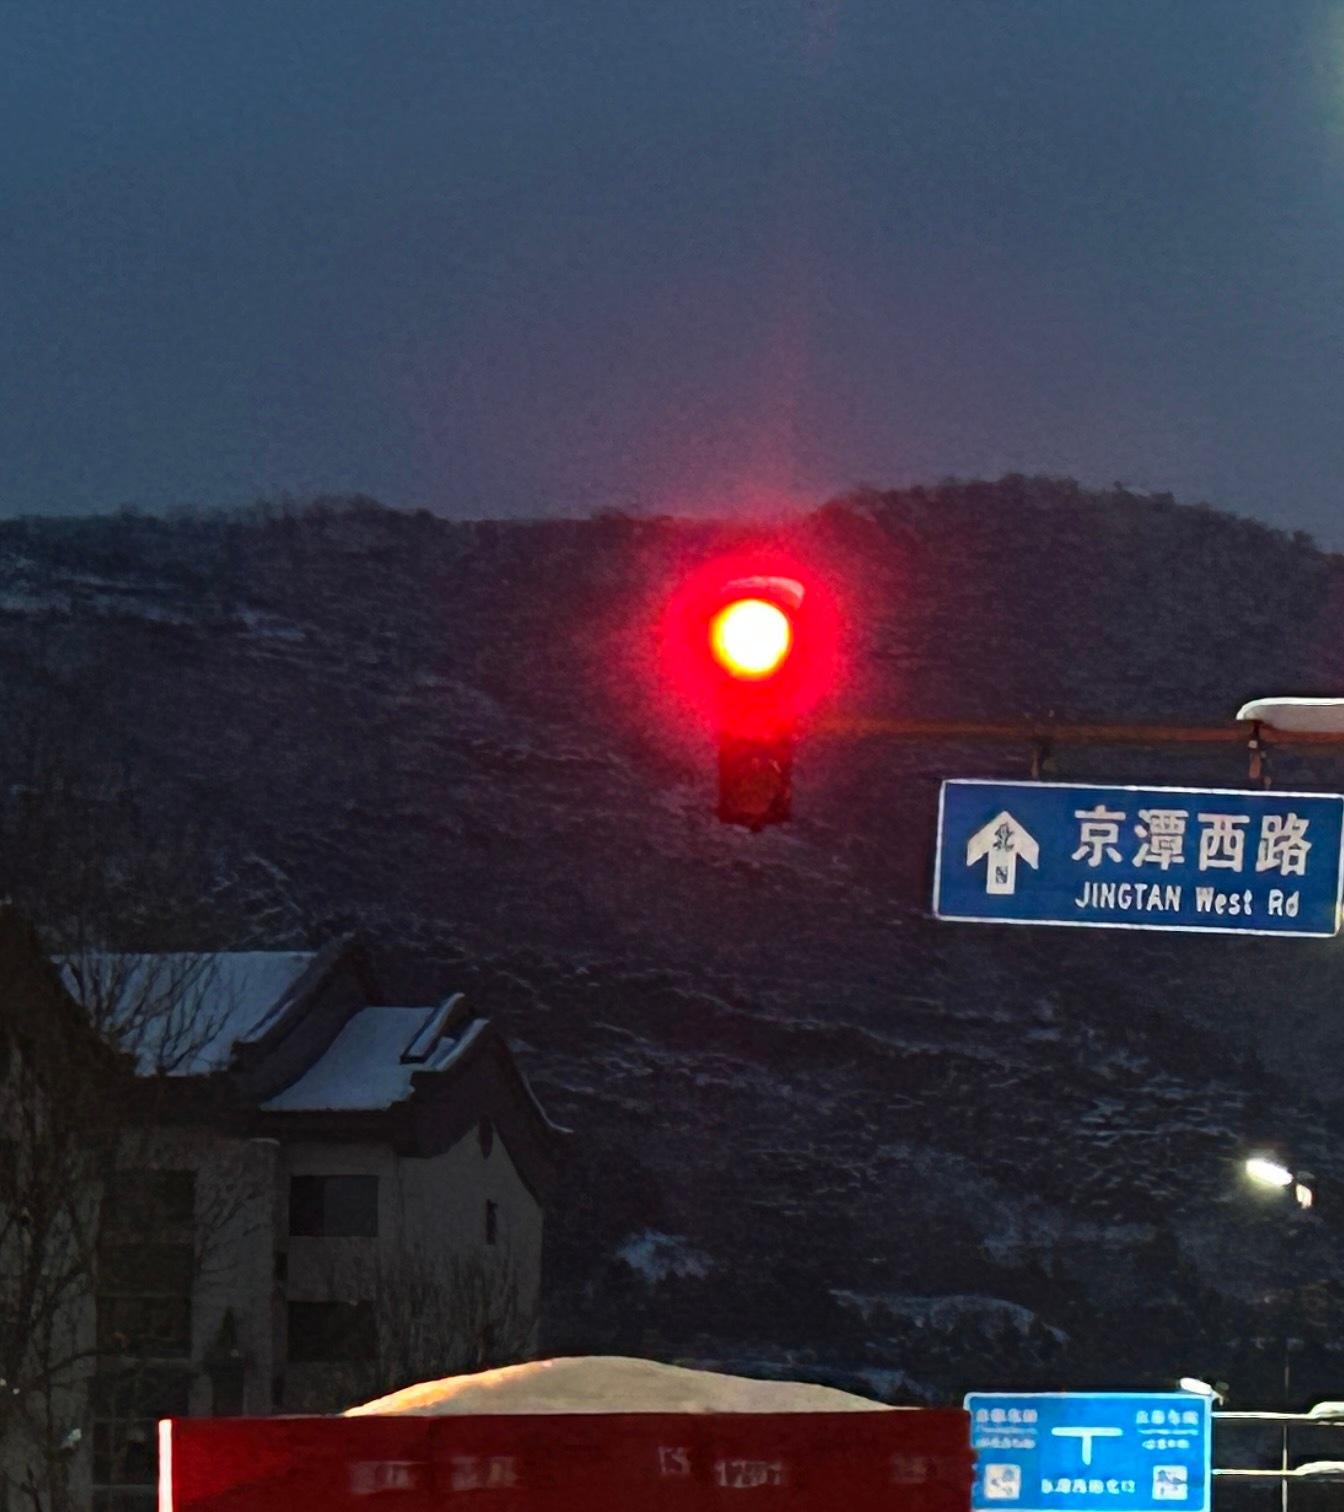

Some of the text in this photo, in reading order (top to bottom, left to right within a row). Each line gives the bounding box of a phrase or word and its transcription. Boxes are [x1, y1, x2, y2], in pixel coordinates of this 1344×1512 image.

[1071, 804, 1312, 877] 京潭西路
[1075, 881, 1299, 918] JINGTAN West Rd
